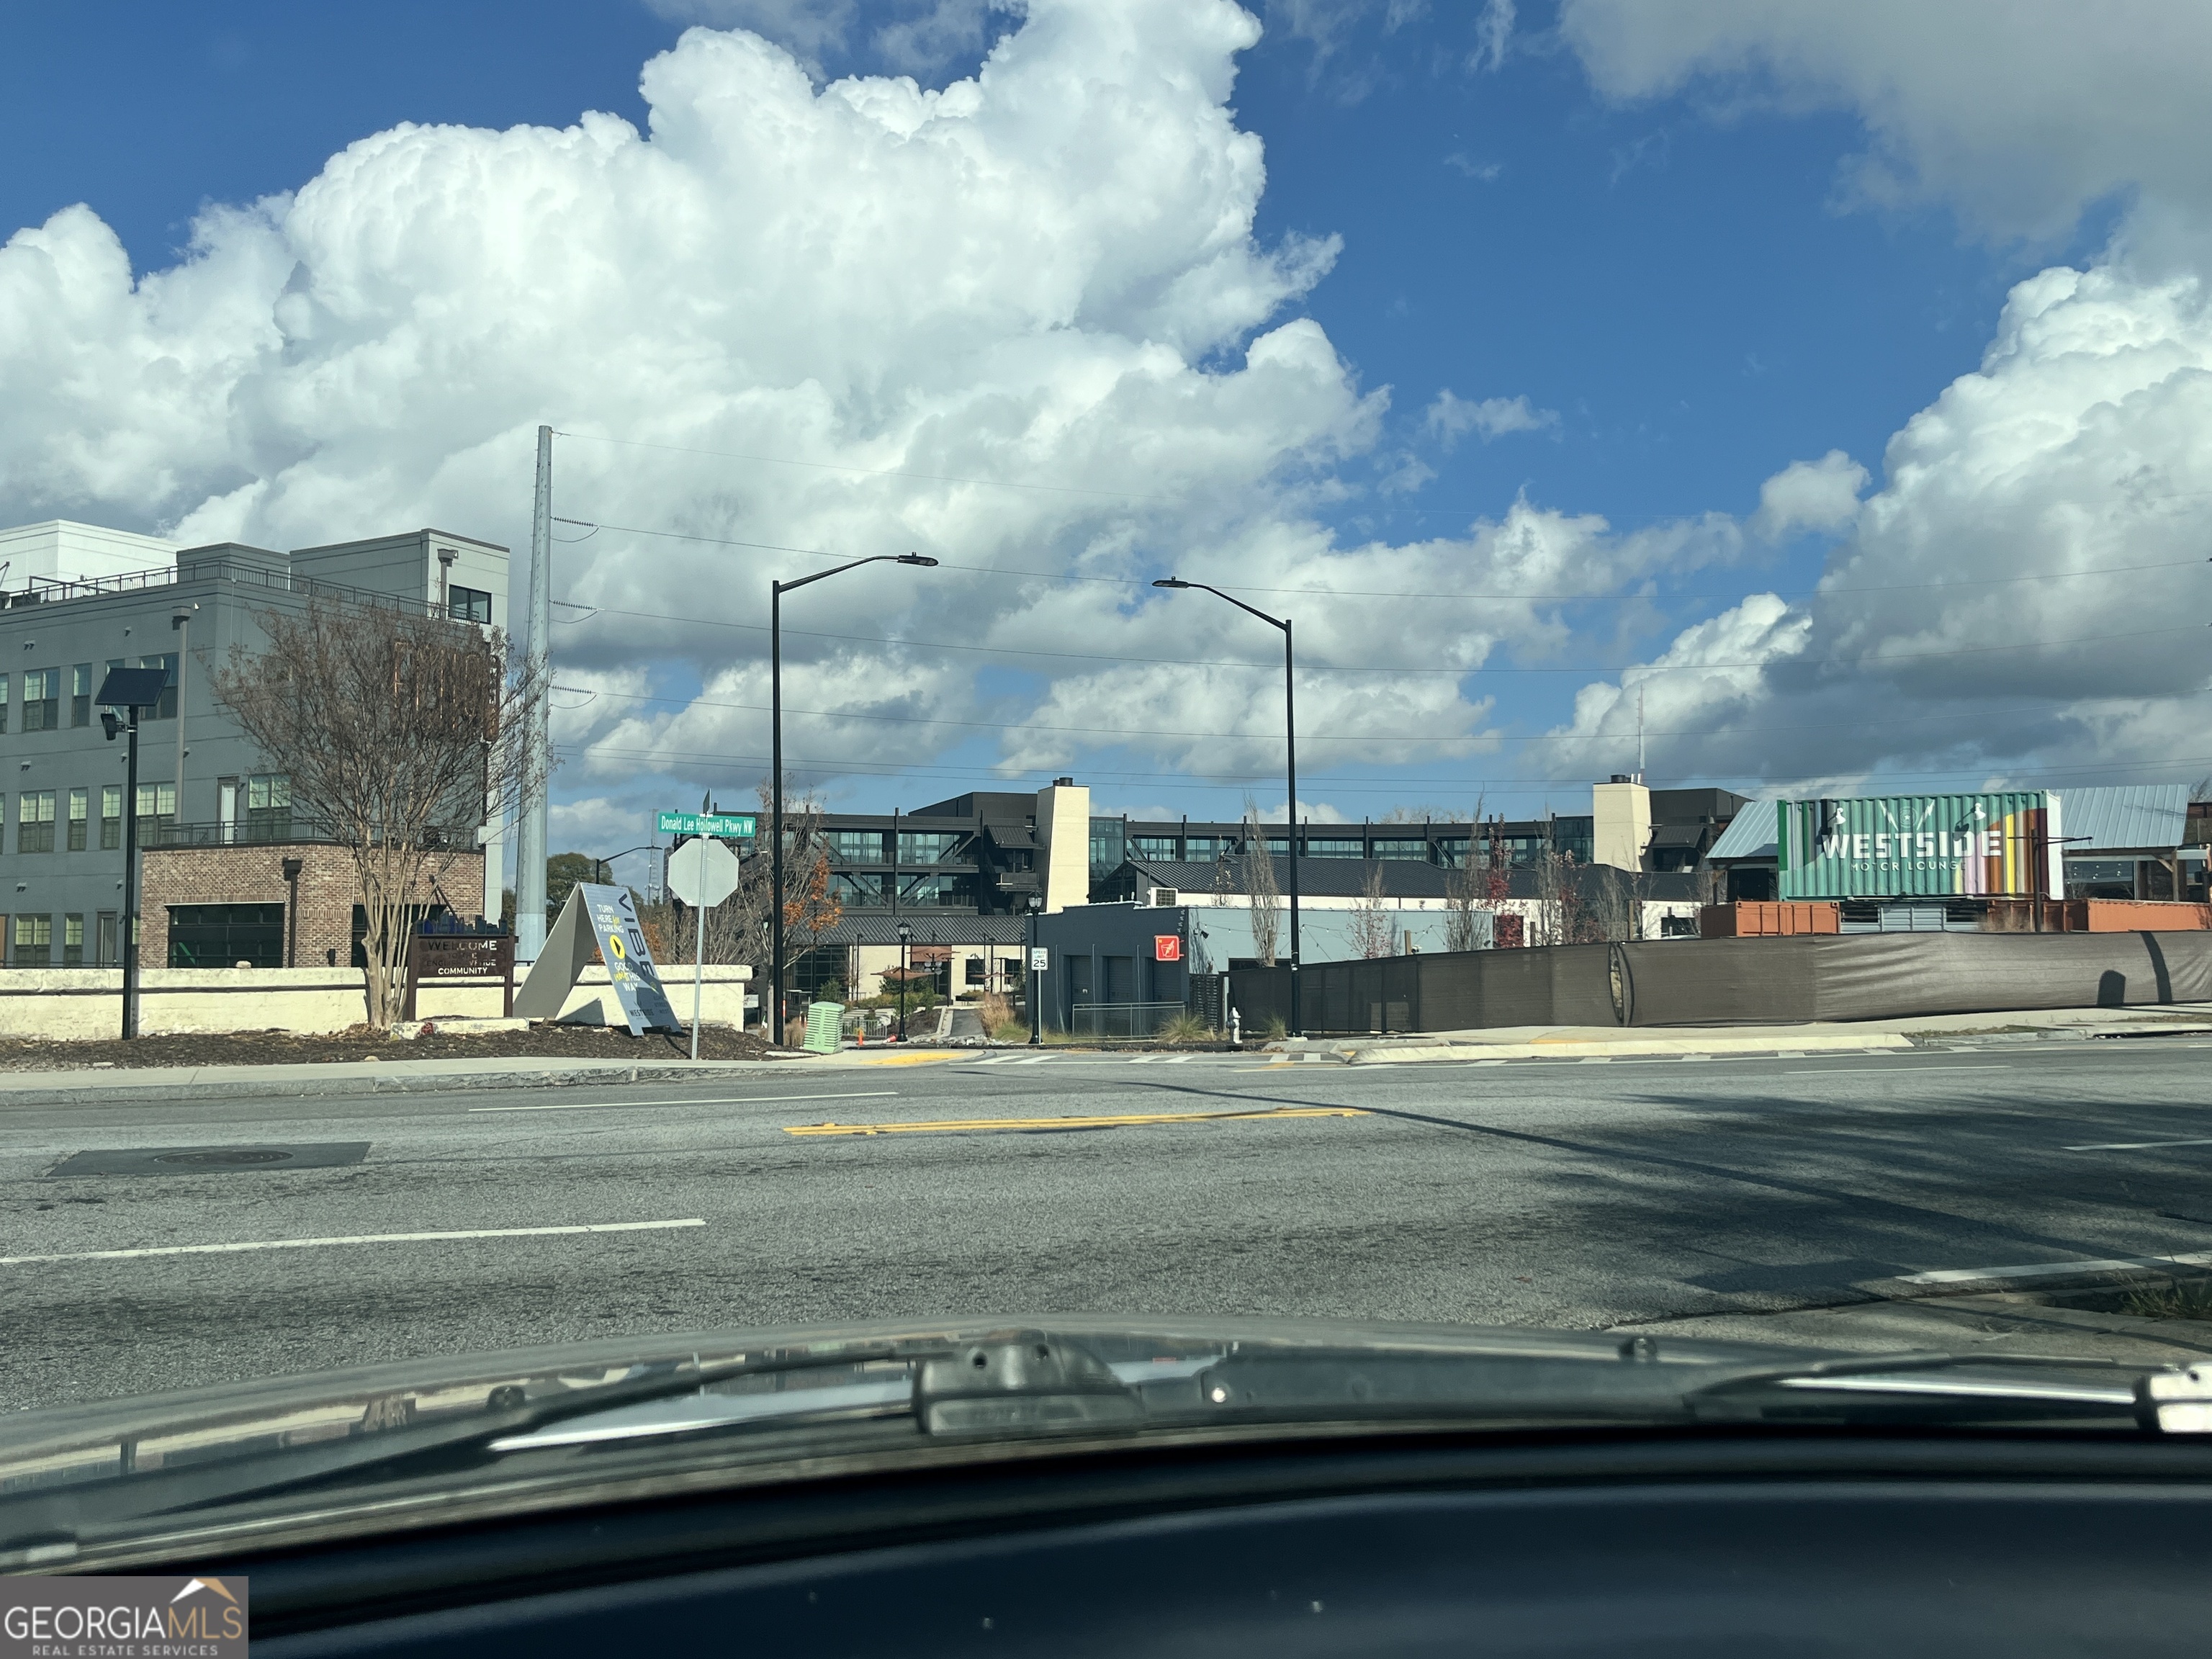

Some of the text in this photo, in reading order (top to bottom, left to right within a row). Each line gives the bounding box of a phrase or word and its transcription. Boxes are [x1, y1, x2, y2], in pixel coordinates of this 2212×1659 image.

[661, 815, 753, 836] Donald Lee Hollowell Pkwy NW
[1822, 830, 2002, 859] WESTSIDE
[1851, 860, 1966, 871] MOTOR LOUNGE
[597, 904, 614, 914] TURN
[596, 914, 613, 923] HERE
[598, 923, 624, 934] PARKING
[428, 940, 497, 950] WELCOME
[614, 961, 634, 972] GOOD
[1033, 959, 1046, 968] 25
[622, 981, 639, 992] WAY
